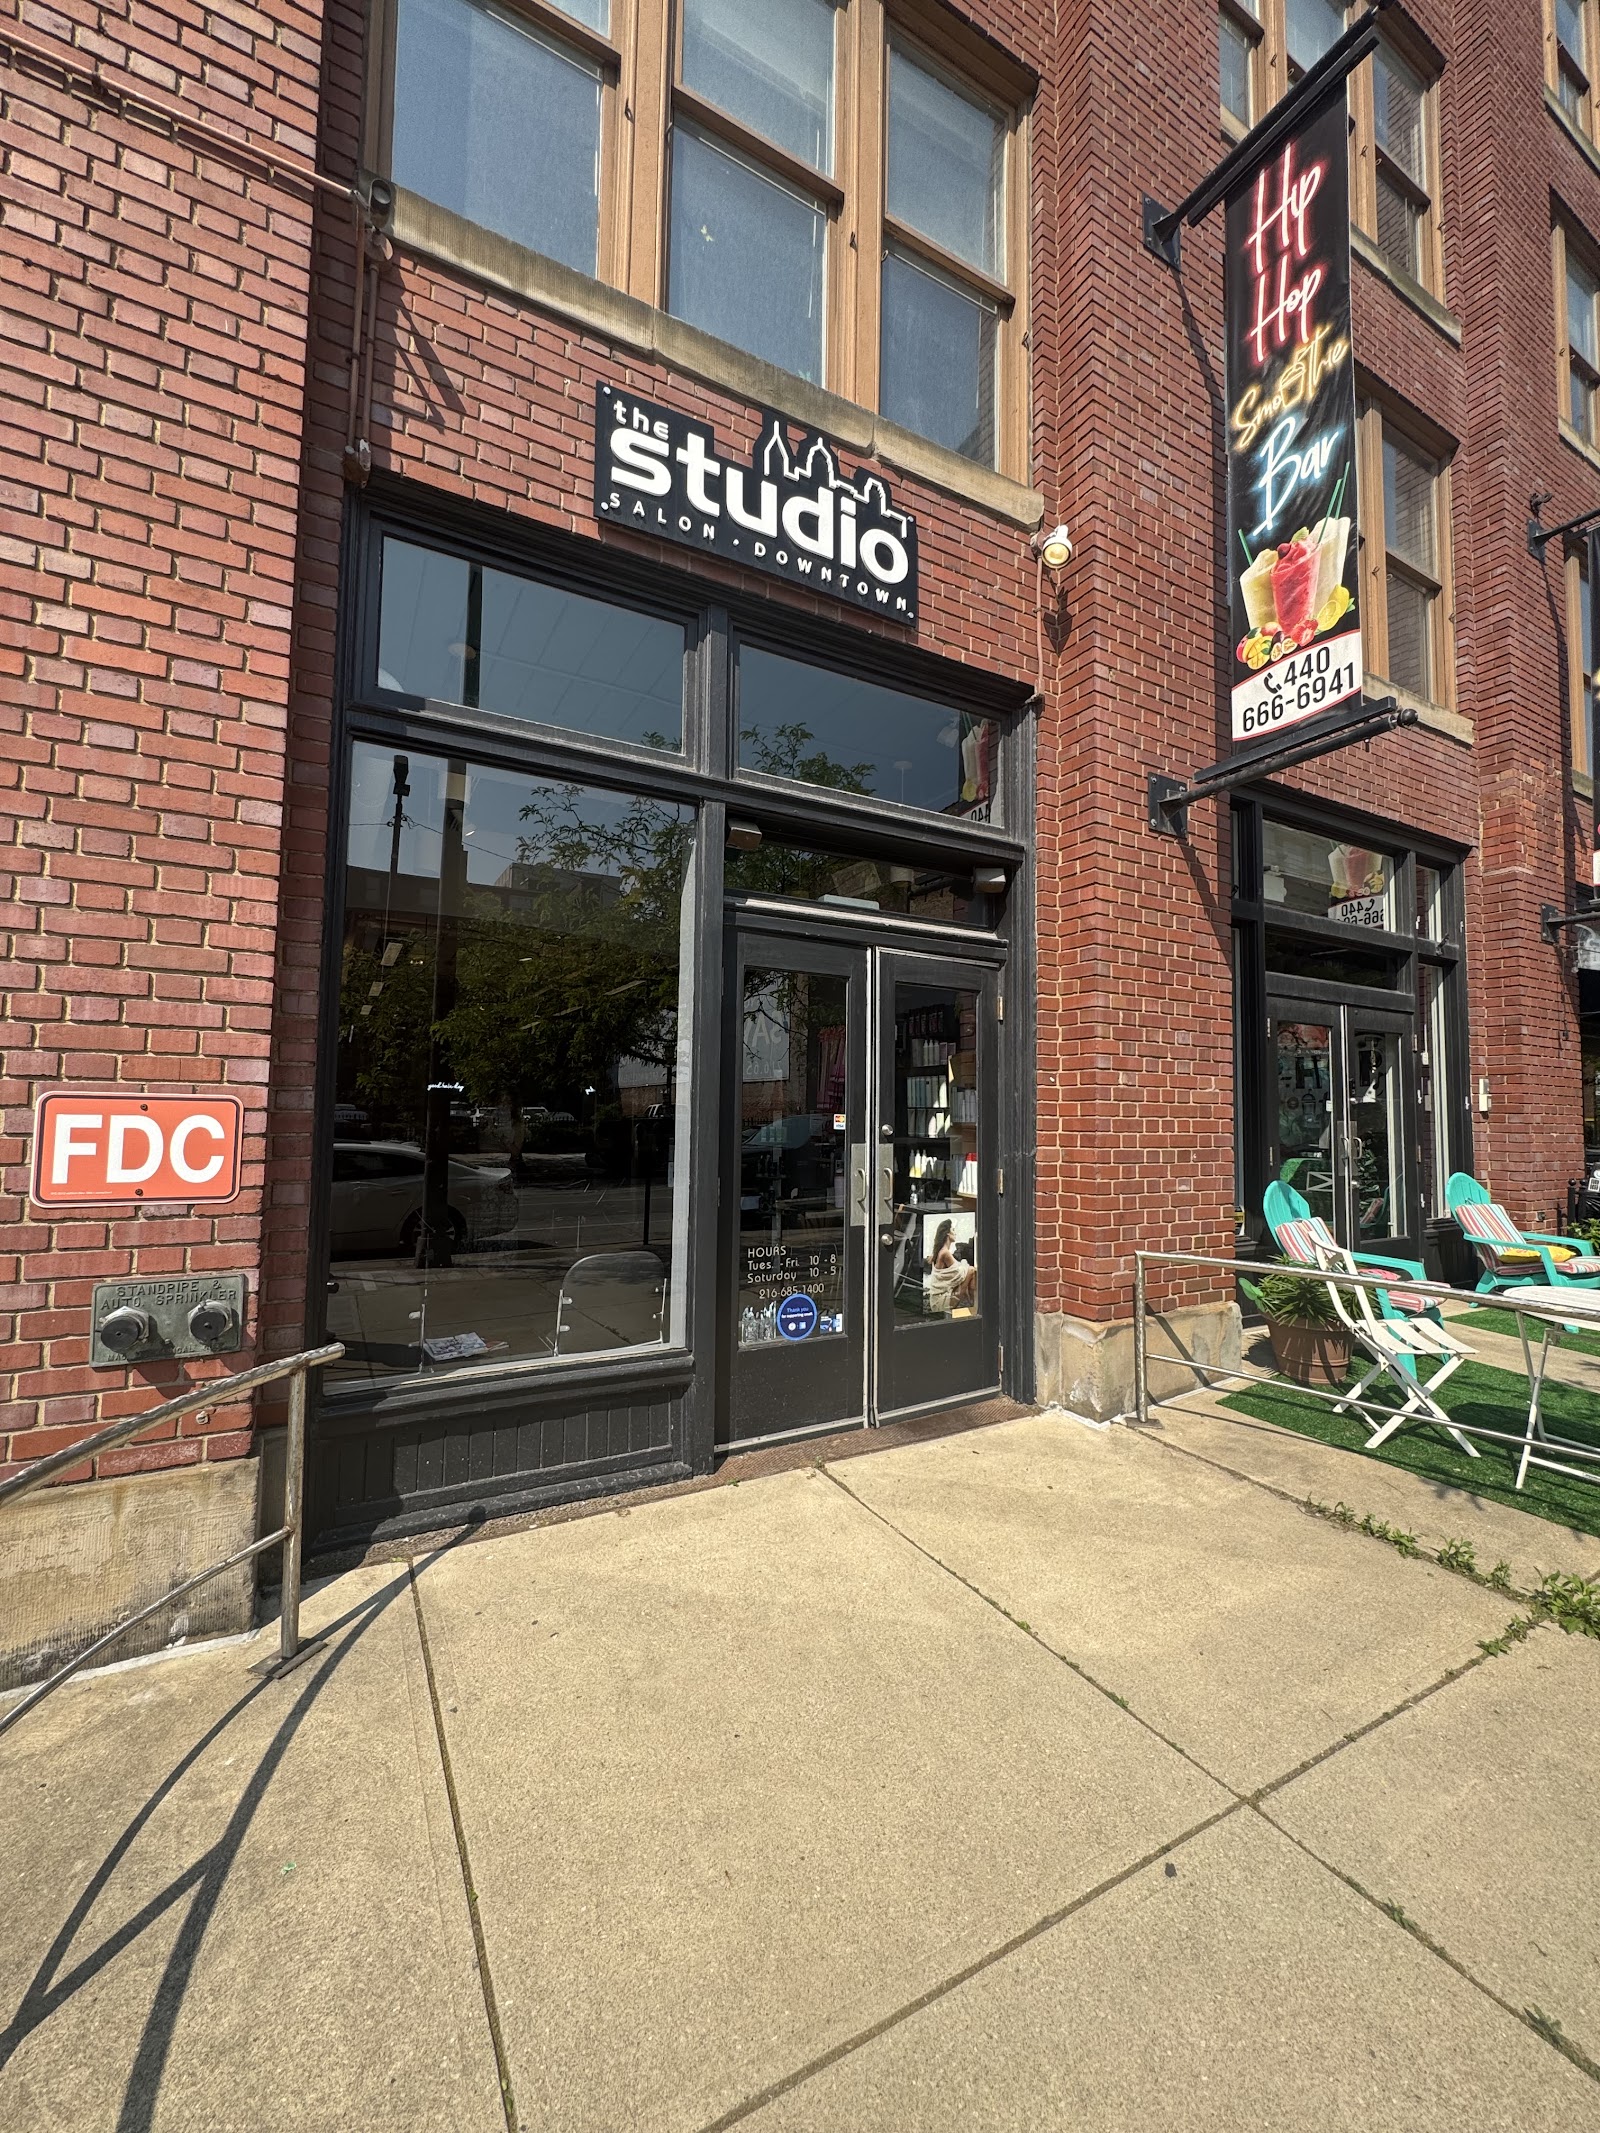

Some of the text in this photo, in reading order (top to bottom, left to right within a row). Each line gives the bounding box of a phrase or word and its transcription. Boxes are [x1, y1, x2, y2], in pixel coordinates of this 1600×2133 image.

[1247, 142, 1321, 274] Hip
[1250, 253, 1321, 362] Hop
[613, 400, 670, 441] the
[1253, 416, 1340, 536] Bar
[610, 427, 909, 585] studio
[609, 492, 908, 612] SALON DOWNTOWN
[1285, 646, 1331, 688] 440
[1242, 662, 1355, 733] 666-6941
[51, 1114, 225, 1184] FDC
[747, 1245, 787, 1258] HOURS
[747, 1260, 774, 1271] Tues.
[785, 1257, 800, 1268] Fri.
[809, 1255, 820, 1266] 10
[829, 1253, 837, 1264] 8
[116, 1280, 222, 1297] STANDPIPE &
[747, 1270, 797, 1284] Saturday
[809, 1267, 820, 1277] 10
[830, 1265, 837, 1276] 5
[759, 1283, 825, 1300] 216-685-1400
[155, 1289, 237, 1306] SPRINKLER
